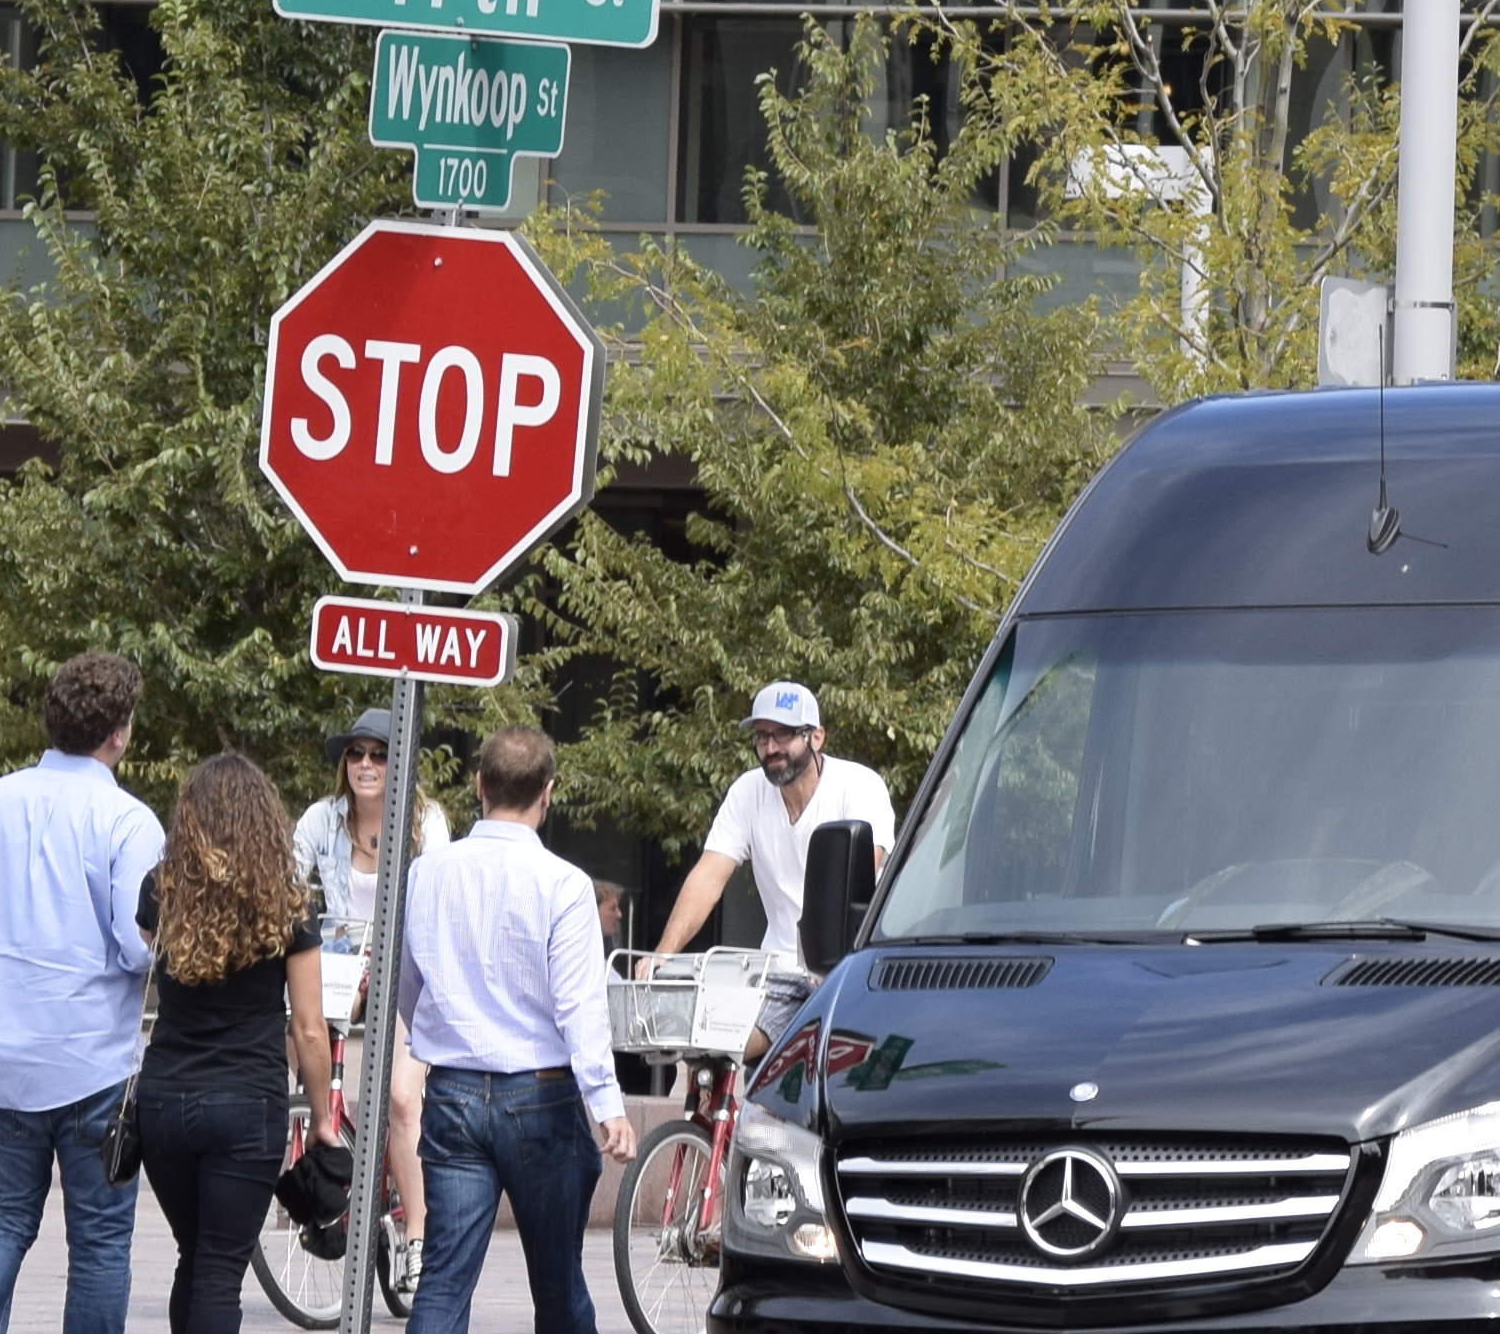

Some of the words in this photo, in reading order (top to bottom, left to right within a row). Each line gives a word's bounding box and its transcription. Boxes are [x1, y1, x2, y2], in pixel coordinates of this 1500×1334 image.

[387, 43, 528, 141] Wynkoop
[537, 78, 559, 118] St
[438, 156, 487, 199] 1700
[291, 334, 561, 478] STOP
[332, 615, 396, 662] ALL
[416, 623, 487, 668] WAY
